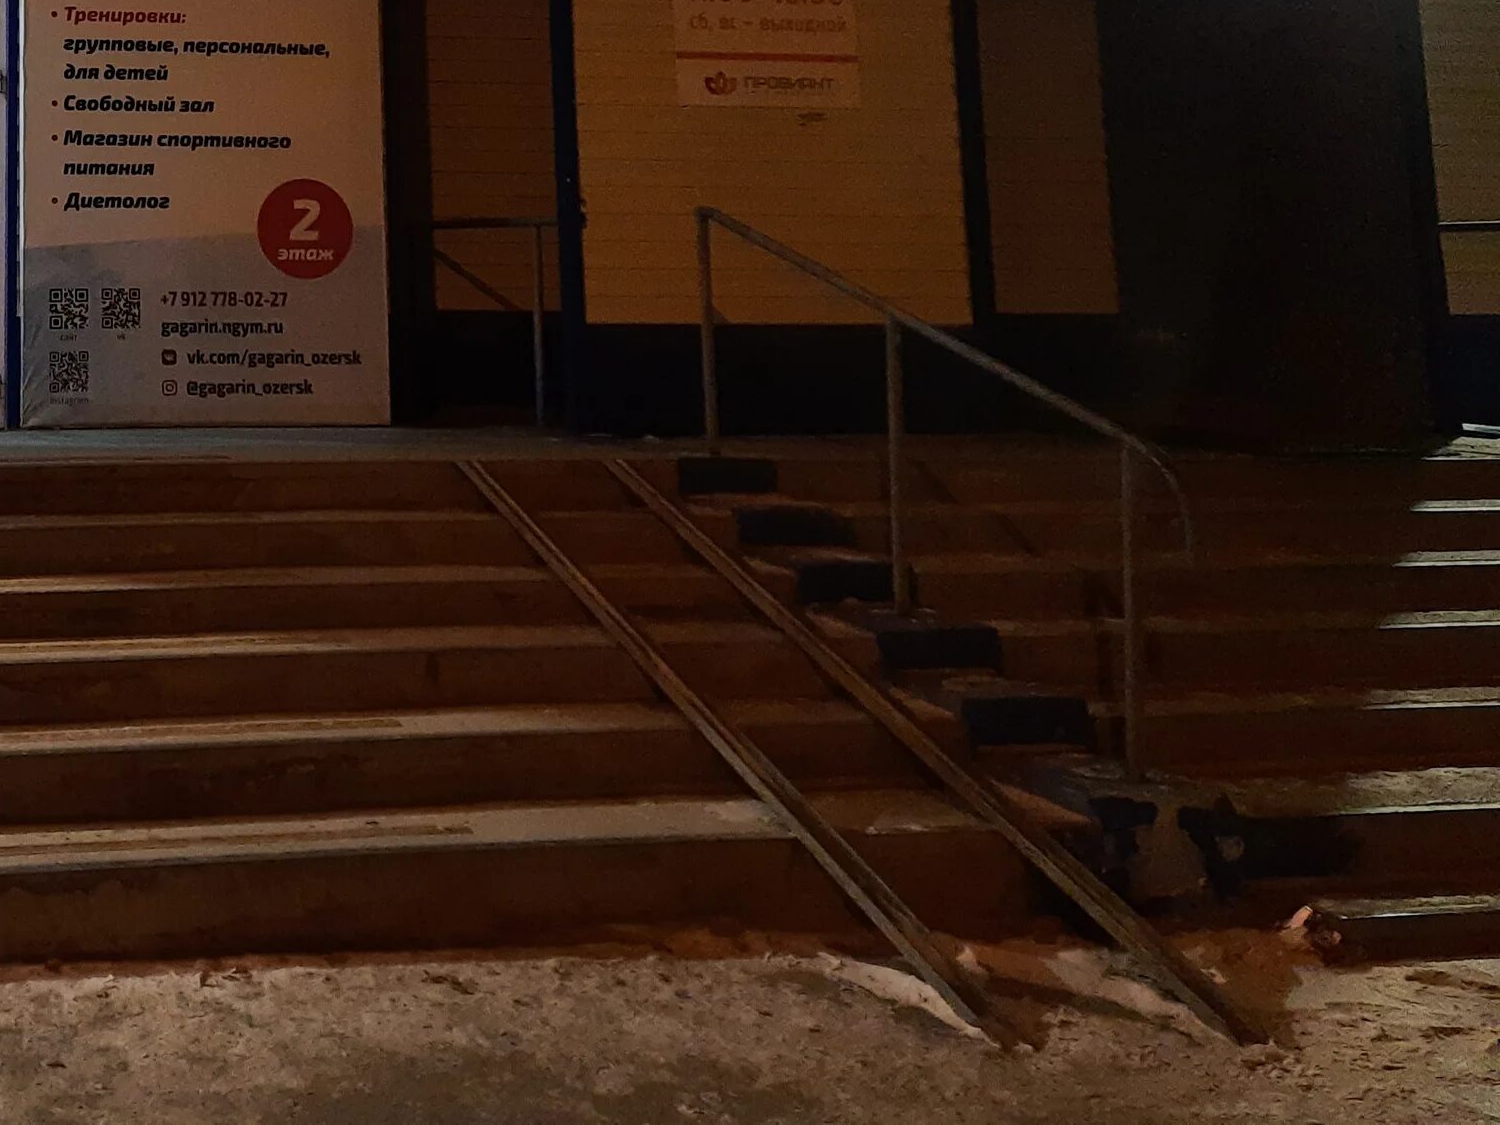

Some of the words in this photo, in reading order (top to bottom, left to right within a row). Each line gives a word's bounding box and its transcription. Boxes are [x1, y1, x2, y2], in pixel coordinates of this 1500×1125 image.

[64, 6, 187, 26] Тренировки:
[63, 38, 180, 57] групповые,
[183, 41, 331, 59] персональные,
[63, 64, 99, 81] для
[103, 64, 169, 82] детей
[63, 95, 176, 113] Свободный
[180, 100, 215, 113] зал
[63, 130, 153, 148] Магазин
[157, 134, 292, 152] спортивного
[63, 161, 155, 176] питания
[63, 192, 171, 211] Диетолог
[289, 199, 321, 241] 2
[277, 248, 334, 261] этаж
[160, 292, 179, 307] +7
[182, 292, 207, 307] 912
[211, 292, 288, 307] 778-02-27
[161, 321, 283, 337] gagarin.ngym.ru
[186, 350, 362, 367] vk.com/gagarin_ozersk
[186, 380, 313, 396] @gagarin_ozersk
